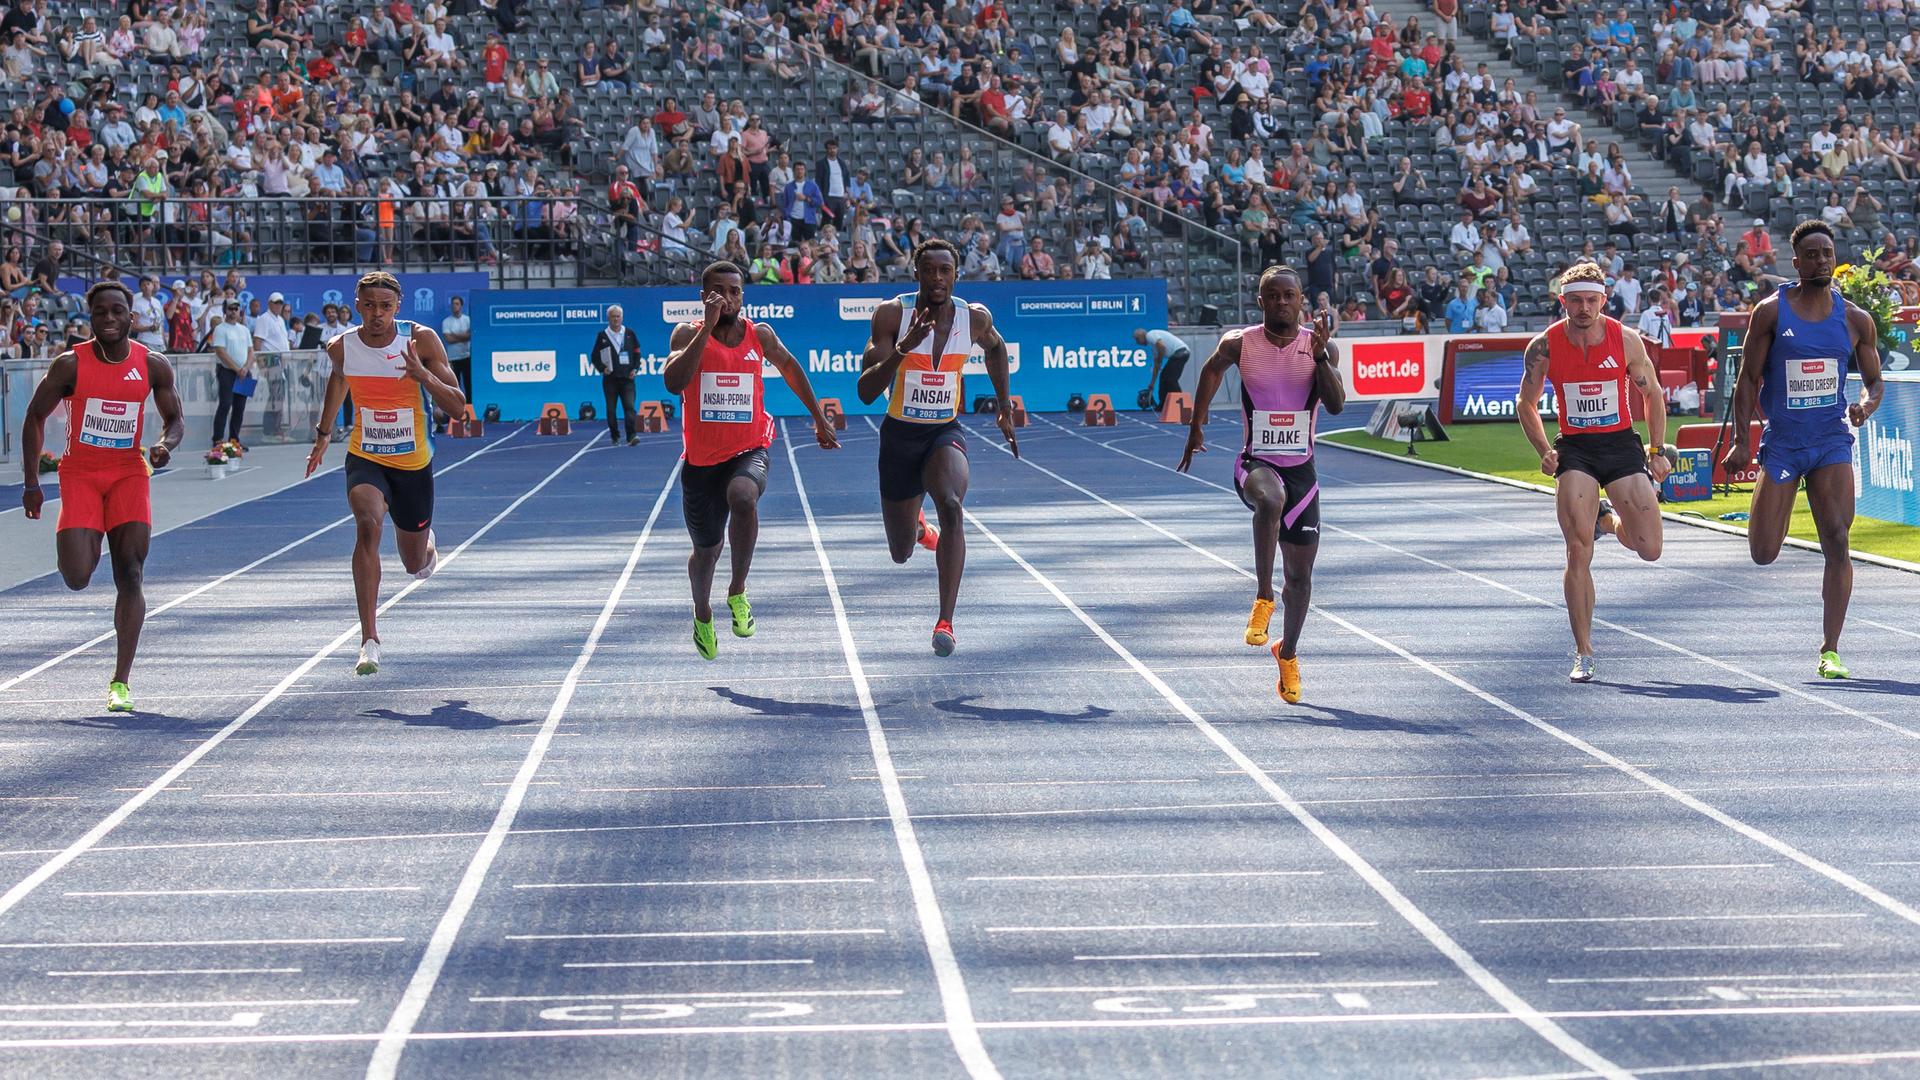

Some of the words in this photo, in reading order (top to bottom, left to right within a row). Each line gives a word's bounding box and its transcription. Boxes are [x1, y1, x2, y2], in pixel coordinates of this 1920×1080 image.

[740, 303, 794, 319] atratze
[1021, 301, 1083, 310] SPORTMETROPOLE
[1091, 300, 1122, 310] BERLIN
[495, 311, 558, 319] SPORTMETROPOLE
[566, 310, 598, 319] BERLIN
[809, 350, 863, 372] Matr
[1043, 345, 1147, 369] Matratze
[497, 361, 551, 372] bett1.de
[1357, 359, 1420, 379] bett1.de
[1789, 379, 1814, 392] ROMERO
[1815, 376, 1837, 391] CRESPO
[703, 393, 751, 406] ANSAH-PEPRAH
[911, 388, 951, 404] ANSAH
[1804, 397, 1821, 406] 2025
[1576, 397, 1608, 413] WOLF
[919, 410, 938, 418] 2025
[84, 414, 136, 434] ONWUZURIKE
[1582, 417, 1601, 427] 2025
[364, 427, 412, 439] MASWANGANYI
[1262, 429, 1301, 445] BLAKE
[96, 439, 117, 448] 2025
[1669, 471, 1698, 485] macht
